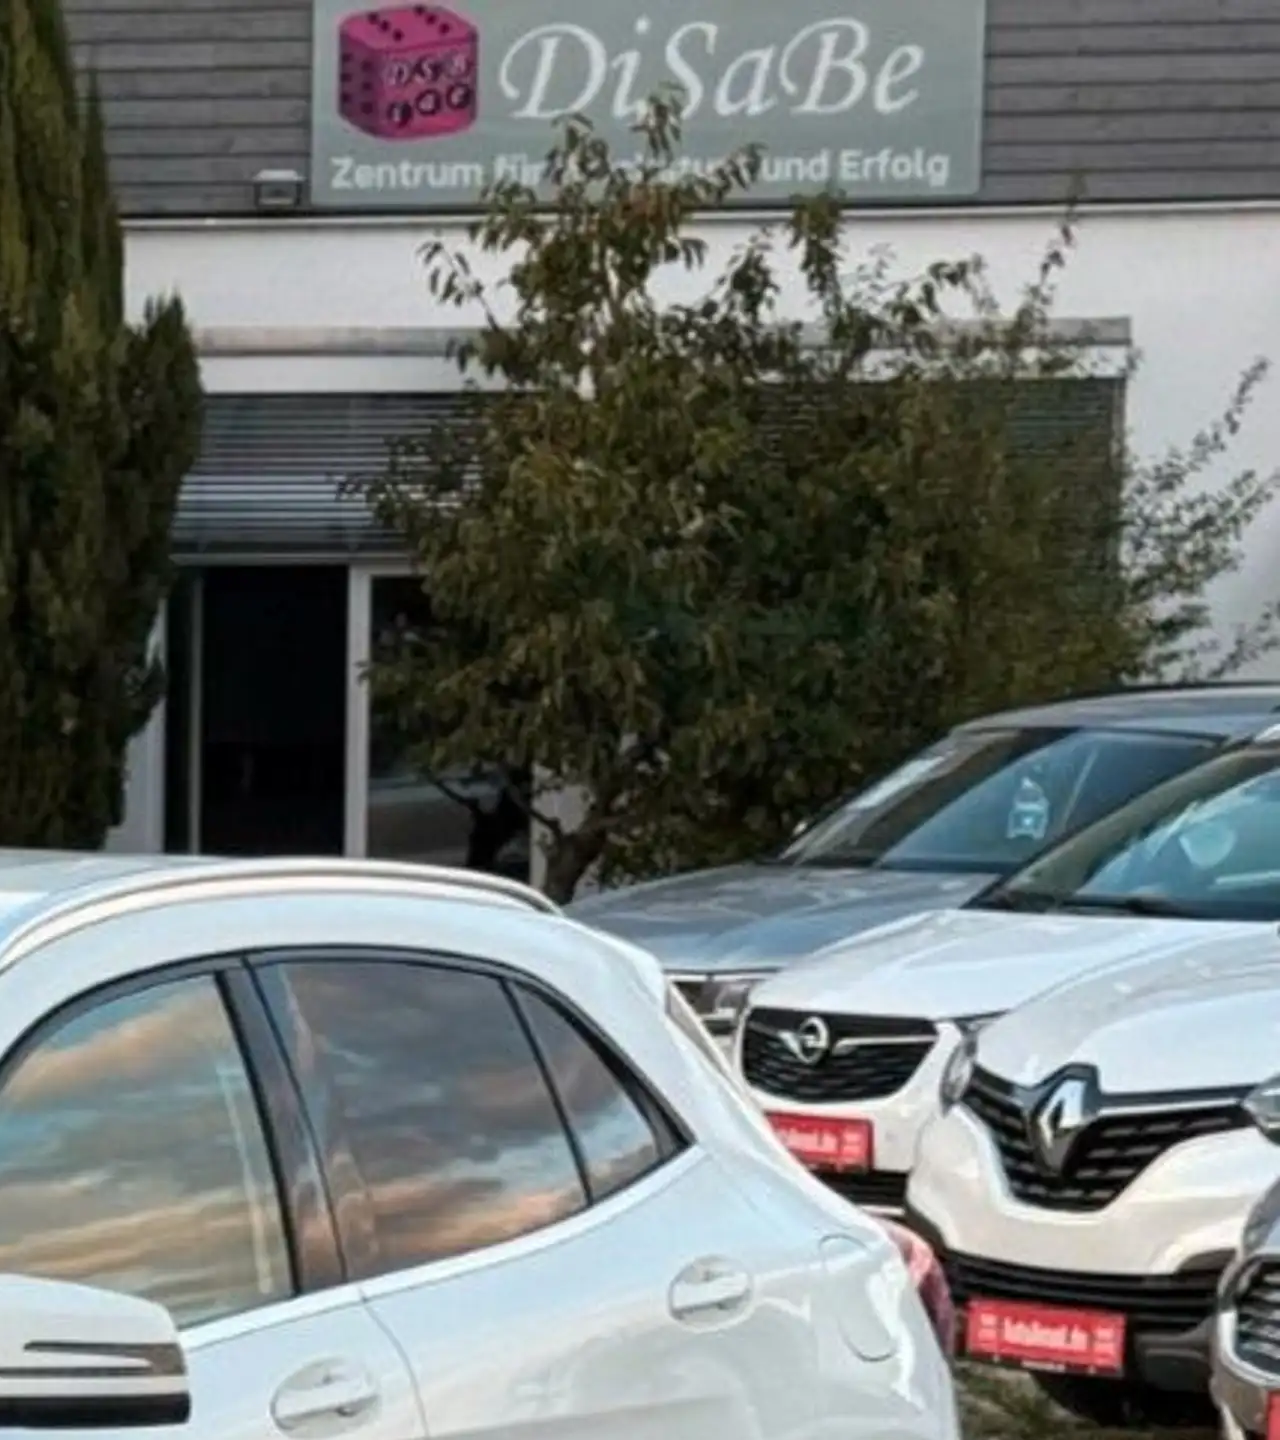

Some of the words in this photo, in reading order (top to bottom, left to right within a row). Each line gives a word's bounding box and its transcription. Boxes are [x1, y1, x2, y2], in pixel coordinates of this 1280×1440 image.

[498, 17, 925, 120] DiSaBe
[330, 157, 483, 190] Zentrum
[758, 150, 829, 182] und
[841, 149, 950, 187] Erfolg
